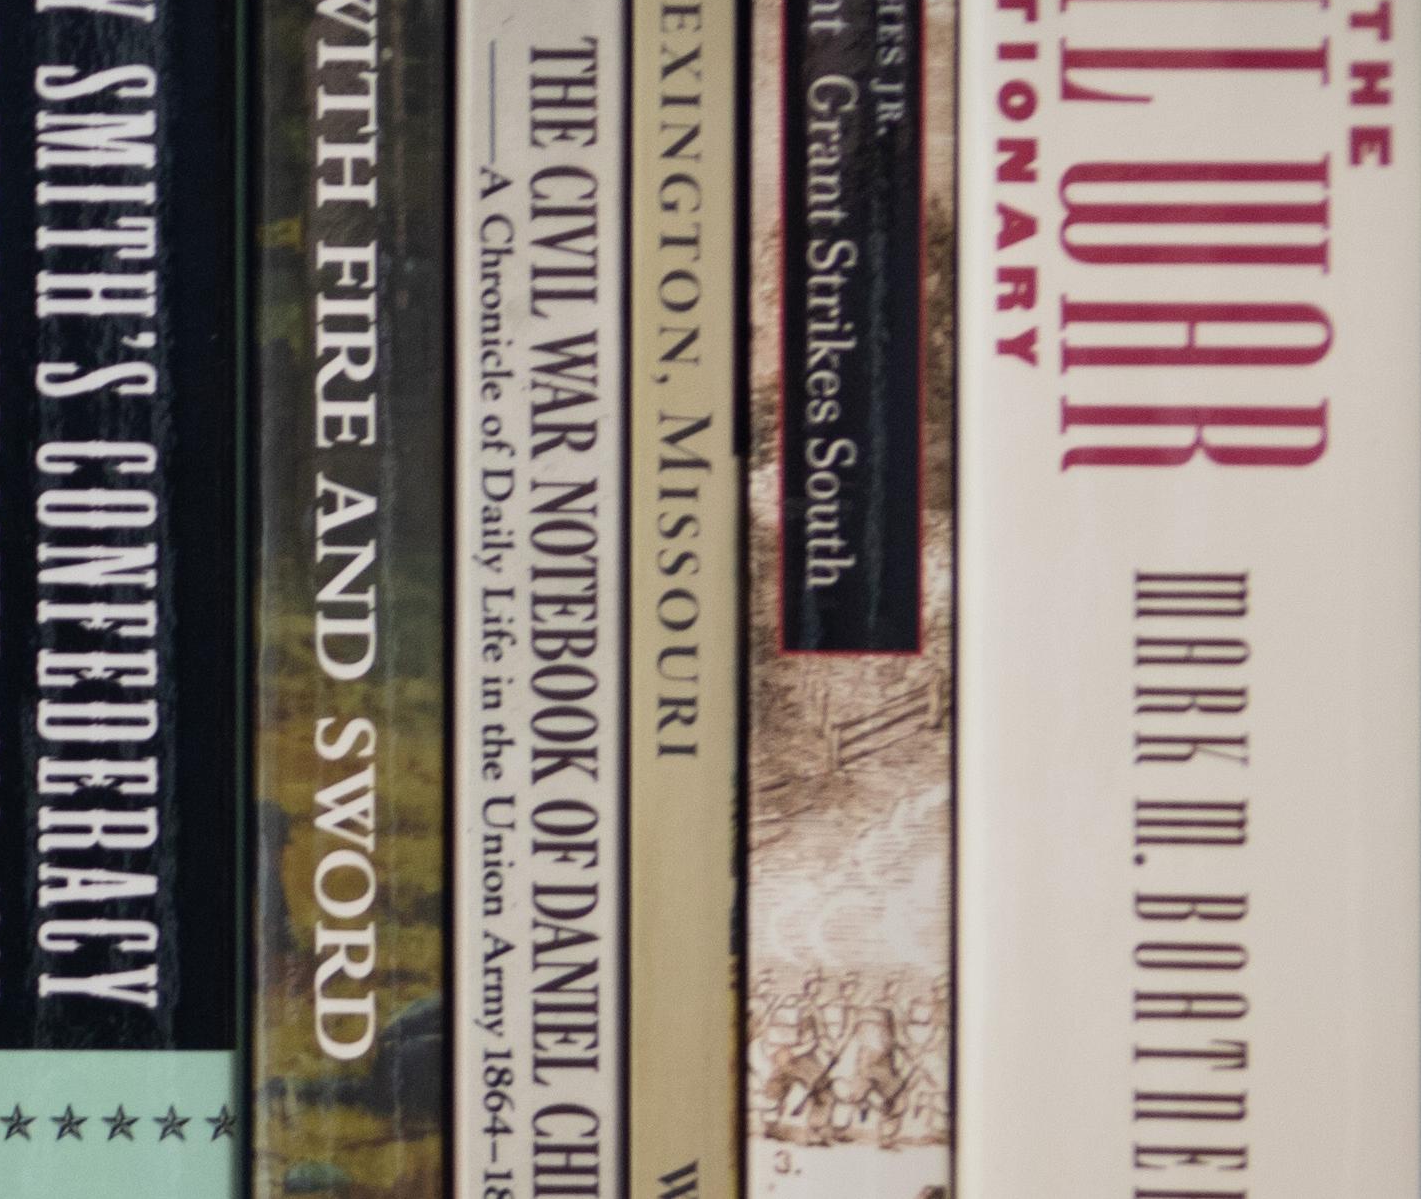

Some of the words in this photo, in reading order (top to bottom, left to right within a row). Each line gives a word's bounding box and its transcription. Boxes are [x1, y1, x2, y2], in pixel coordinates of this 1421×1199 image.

[529, 36, 599, 149] THE
[806, 74, 858, 226] Grant
[870, 77, 905, 136] JR.
[35, 64, 157, 399] SMITH'S
[479, 165, 513, 200] A
[529, 164, 599, 319] CIVIL
[314, 239, 378, 448] FIRE
[479, 214, 515, 402] Chronicle
[805, 238, 858, 425] Strikes
[1059, 152, 1334, 474] WAR
[480, 414, 515, 457] of
[529, 329, 599, 460] WAR
[314, 472, 378, 681] AND
[472, 468, 515, 573] Daily
[656, 413, 713, 758] MISSOURI
[805, 437, 857, 588] South
[481, 588, 517, 663] Life
[481, 675, 514, 711] in
[529, 477, 599, 785] NOTEBOOK
[1133, 569, 1251, 767] MARK
[36, 440, 158, 1008] CONFEDERACY
[481, 723, 515, 781] the
[313, 715, 378, 1062] SWORD
[482, 796, 516, 917] Union
[530, 799, 599, 871] OF
[474, 931, 516, 1037] Army
[531, 882, 600, 1086] DANIEL
